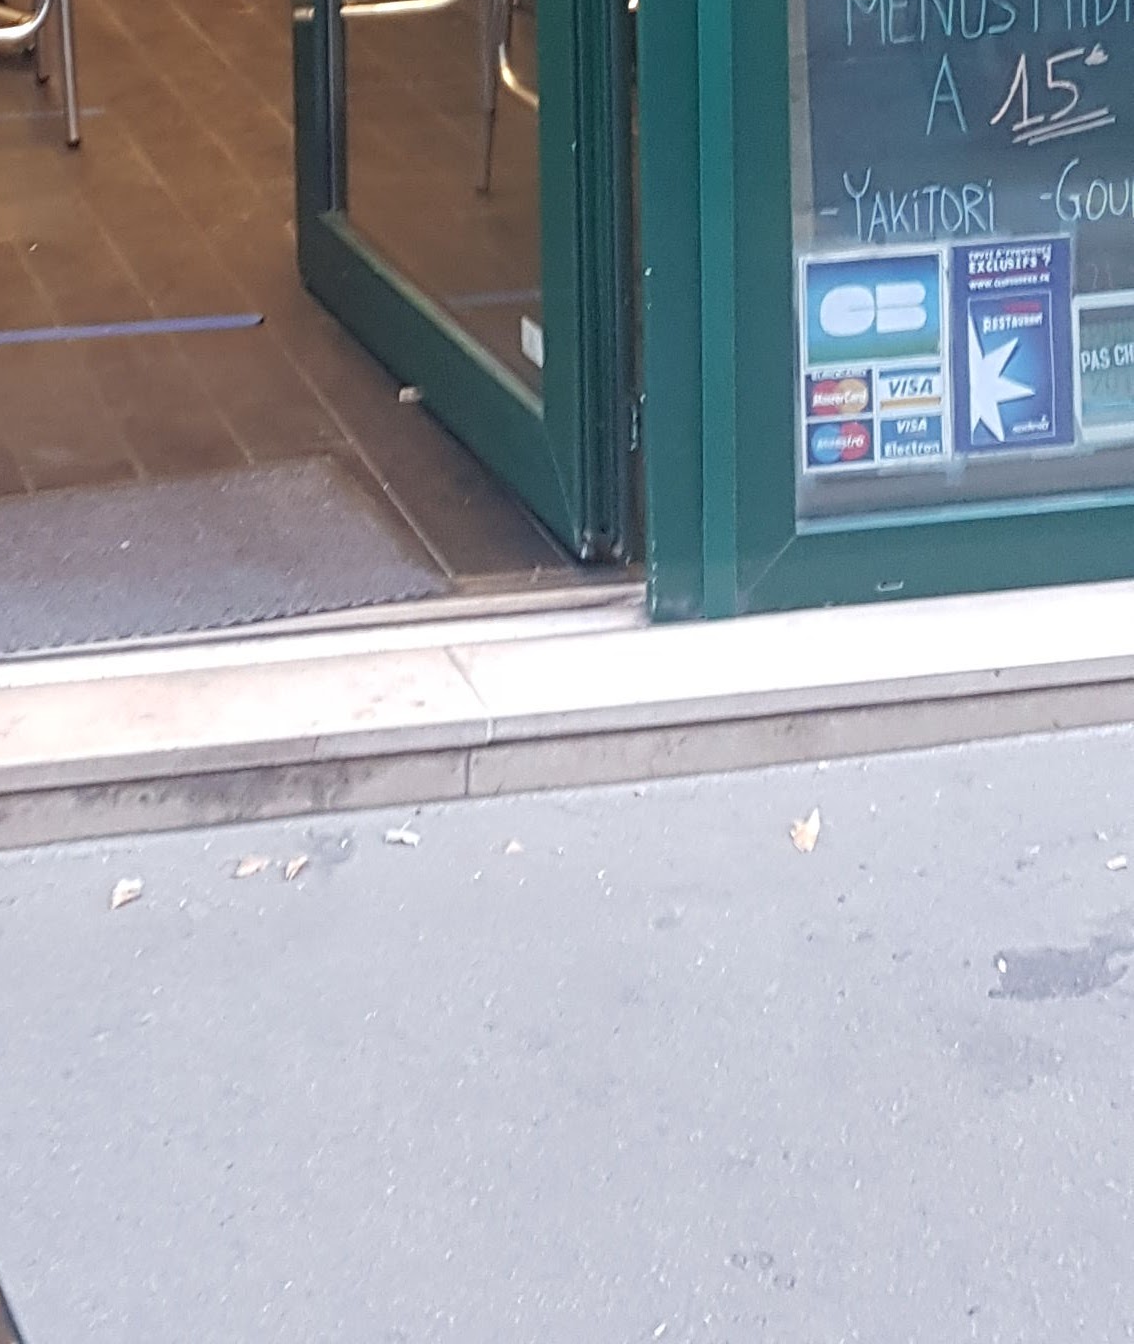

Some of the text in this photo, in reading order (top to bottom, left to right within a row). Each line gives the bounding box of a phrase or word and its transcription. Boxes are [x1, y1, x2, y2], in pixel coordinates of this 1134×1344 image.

[925, 53, 968, 137] A
[968, 257, 1039, 275] EXCLUSIFS
[1081, 348, 1112, 373] PAS
[888, 376, 934, 398] VISA
[896, 417, 928, 434] VISA
[884, 440, 941, 459] Electron
